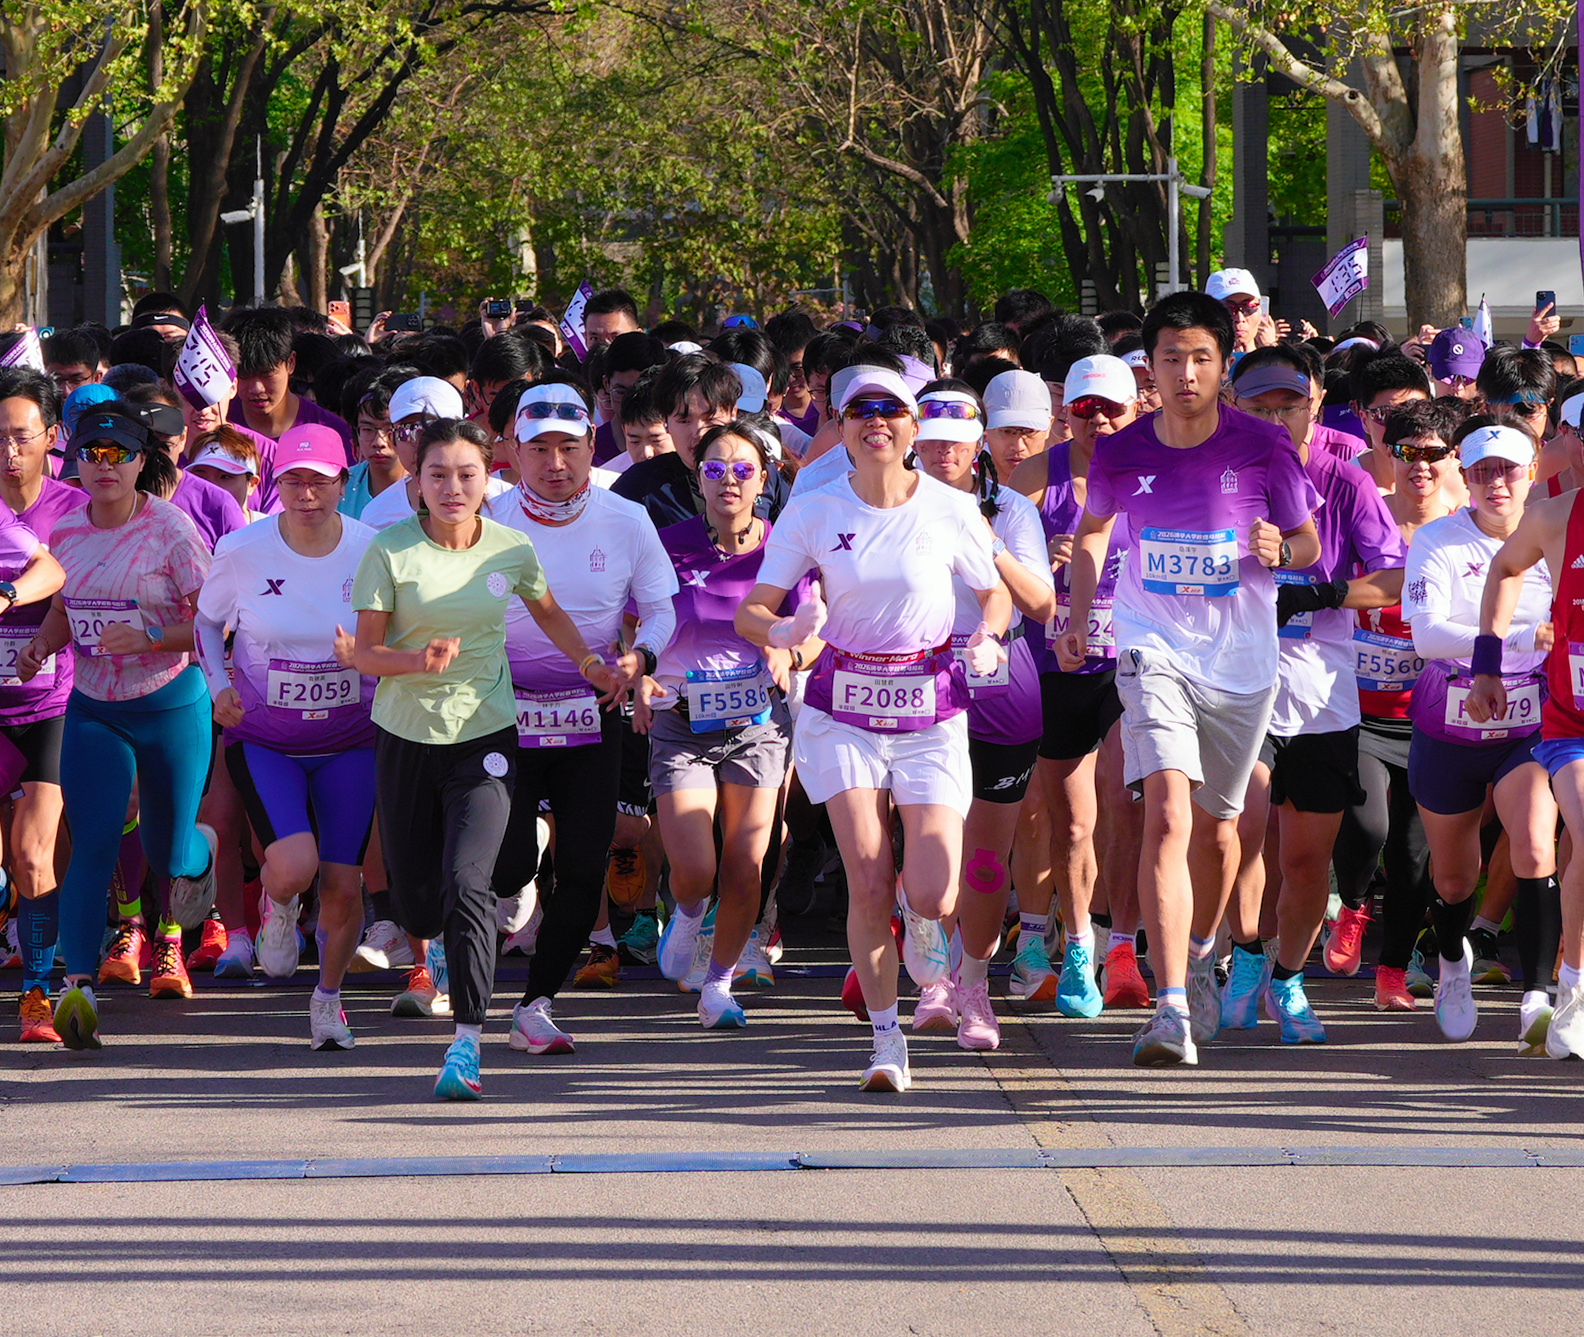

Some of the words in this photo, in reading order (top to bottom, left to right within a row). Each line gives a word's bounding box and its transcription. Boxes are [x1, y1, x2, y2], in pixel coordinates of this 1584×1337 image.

[1147, 553, 1233, 577] M3783
[1358, 652, 1425, 676] F5560
[279, 680, 351, 703] F2059
[700, 685, 767, 713] F5586
[845, 683, 924, 709] F2088
